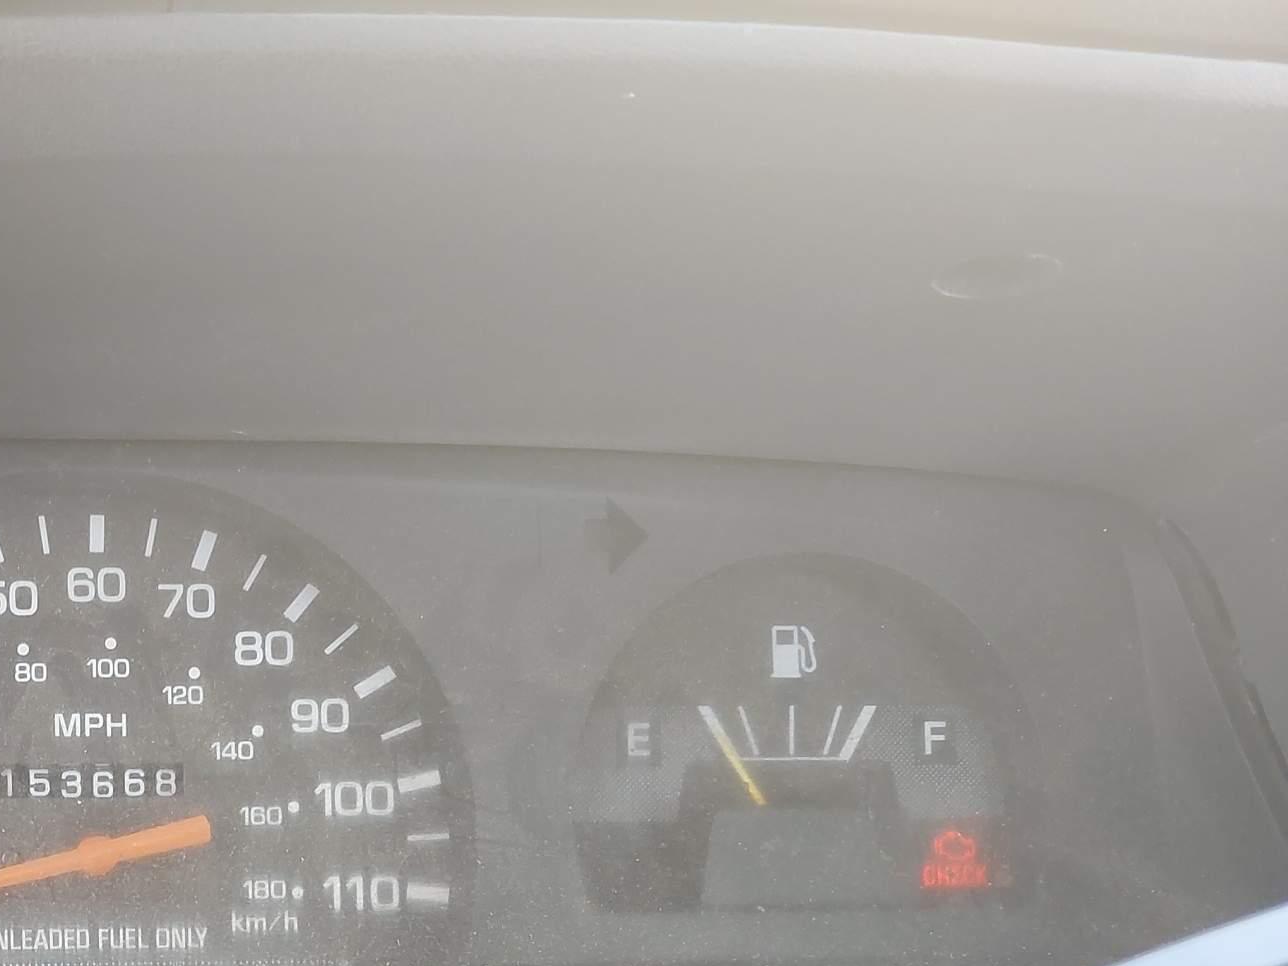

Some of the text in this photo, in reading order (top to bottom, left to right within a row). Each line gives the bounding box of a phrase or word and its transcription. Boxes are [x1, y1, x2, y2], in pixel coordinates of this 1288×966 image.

[66, 567, 126, 603] 60
[158, 583, 216, 619] 70
[234, 630, 294, 666] 80
[14, 662, 48, 682] 80
[86, 658, 130, 678] 100
[162, 686, 204, 705] 120
[54, 713, 127, 737] MPH
[290, 697, 350, 733] 90
[211, 741, 254, 760] 140
[627, 722, 650, 757] E
[923, 720, 947, 755] F
[0, 767, 177, 798] 153668
[314, 780, 394, 817] 100
[239, 805, 283, 826] 160
[242, 879, 287, 900] 180
[322, 876, 400, 911] 110
[231, 910, 299, 934] km/h
[98, 927, 149, 950] FUEL
[155, 927, 208, 949] ONLY
